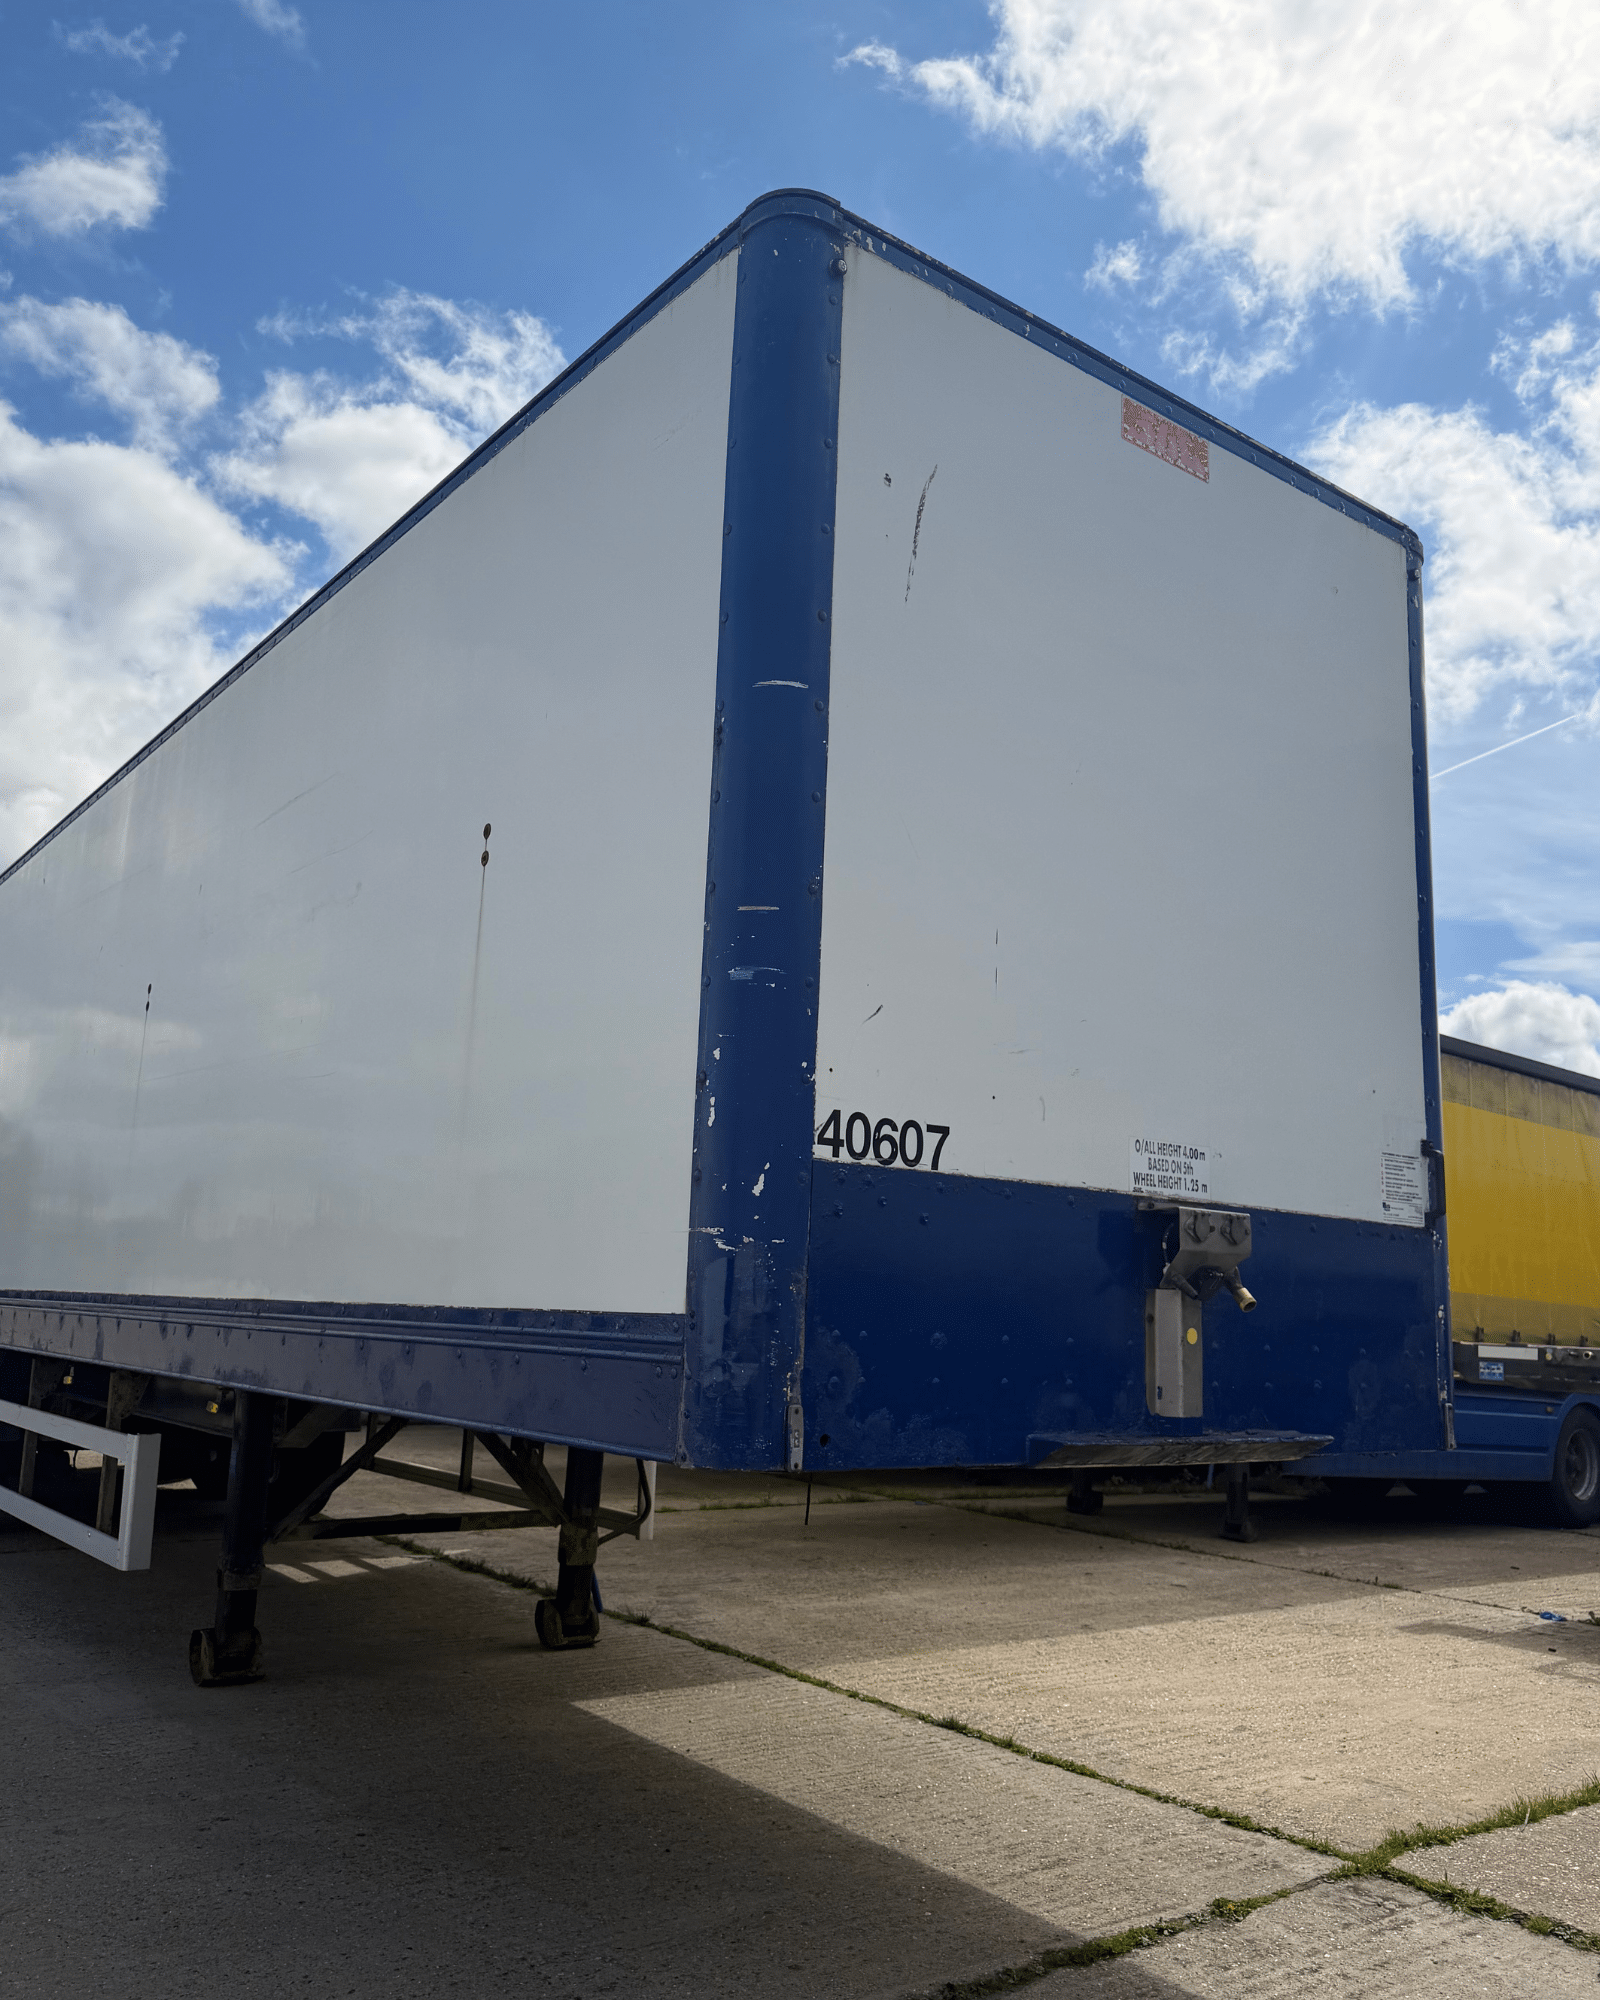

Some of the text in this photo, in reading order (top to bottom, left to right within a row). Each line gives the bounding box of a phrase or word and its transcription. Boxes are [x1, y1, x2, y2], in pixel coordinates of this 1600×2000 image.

[817, 1109, 950, 1171] 40607
[1135, 1139, 1156, 1155] O/ALL
[1157, 1142, 1181, 1158] HEIGHT
[1148, 1157, 1193, 1175] BASED ON 5th
[1133, 1172, 1156, 1187] WHEEL
[1157, 1175, 1182, 1190] HEIGHT
